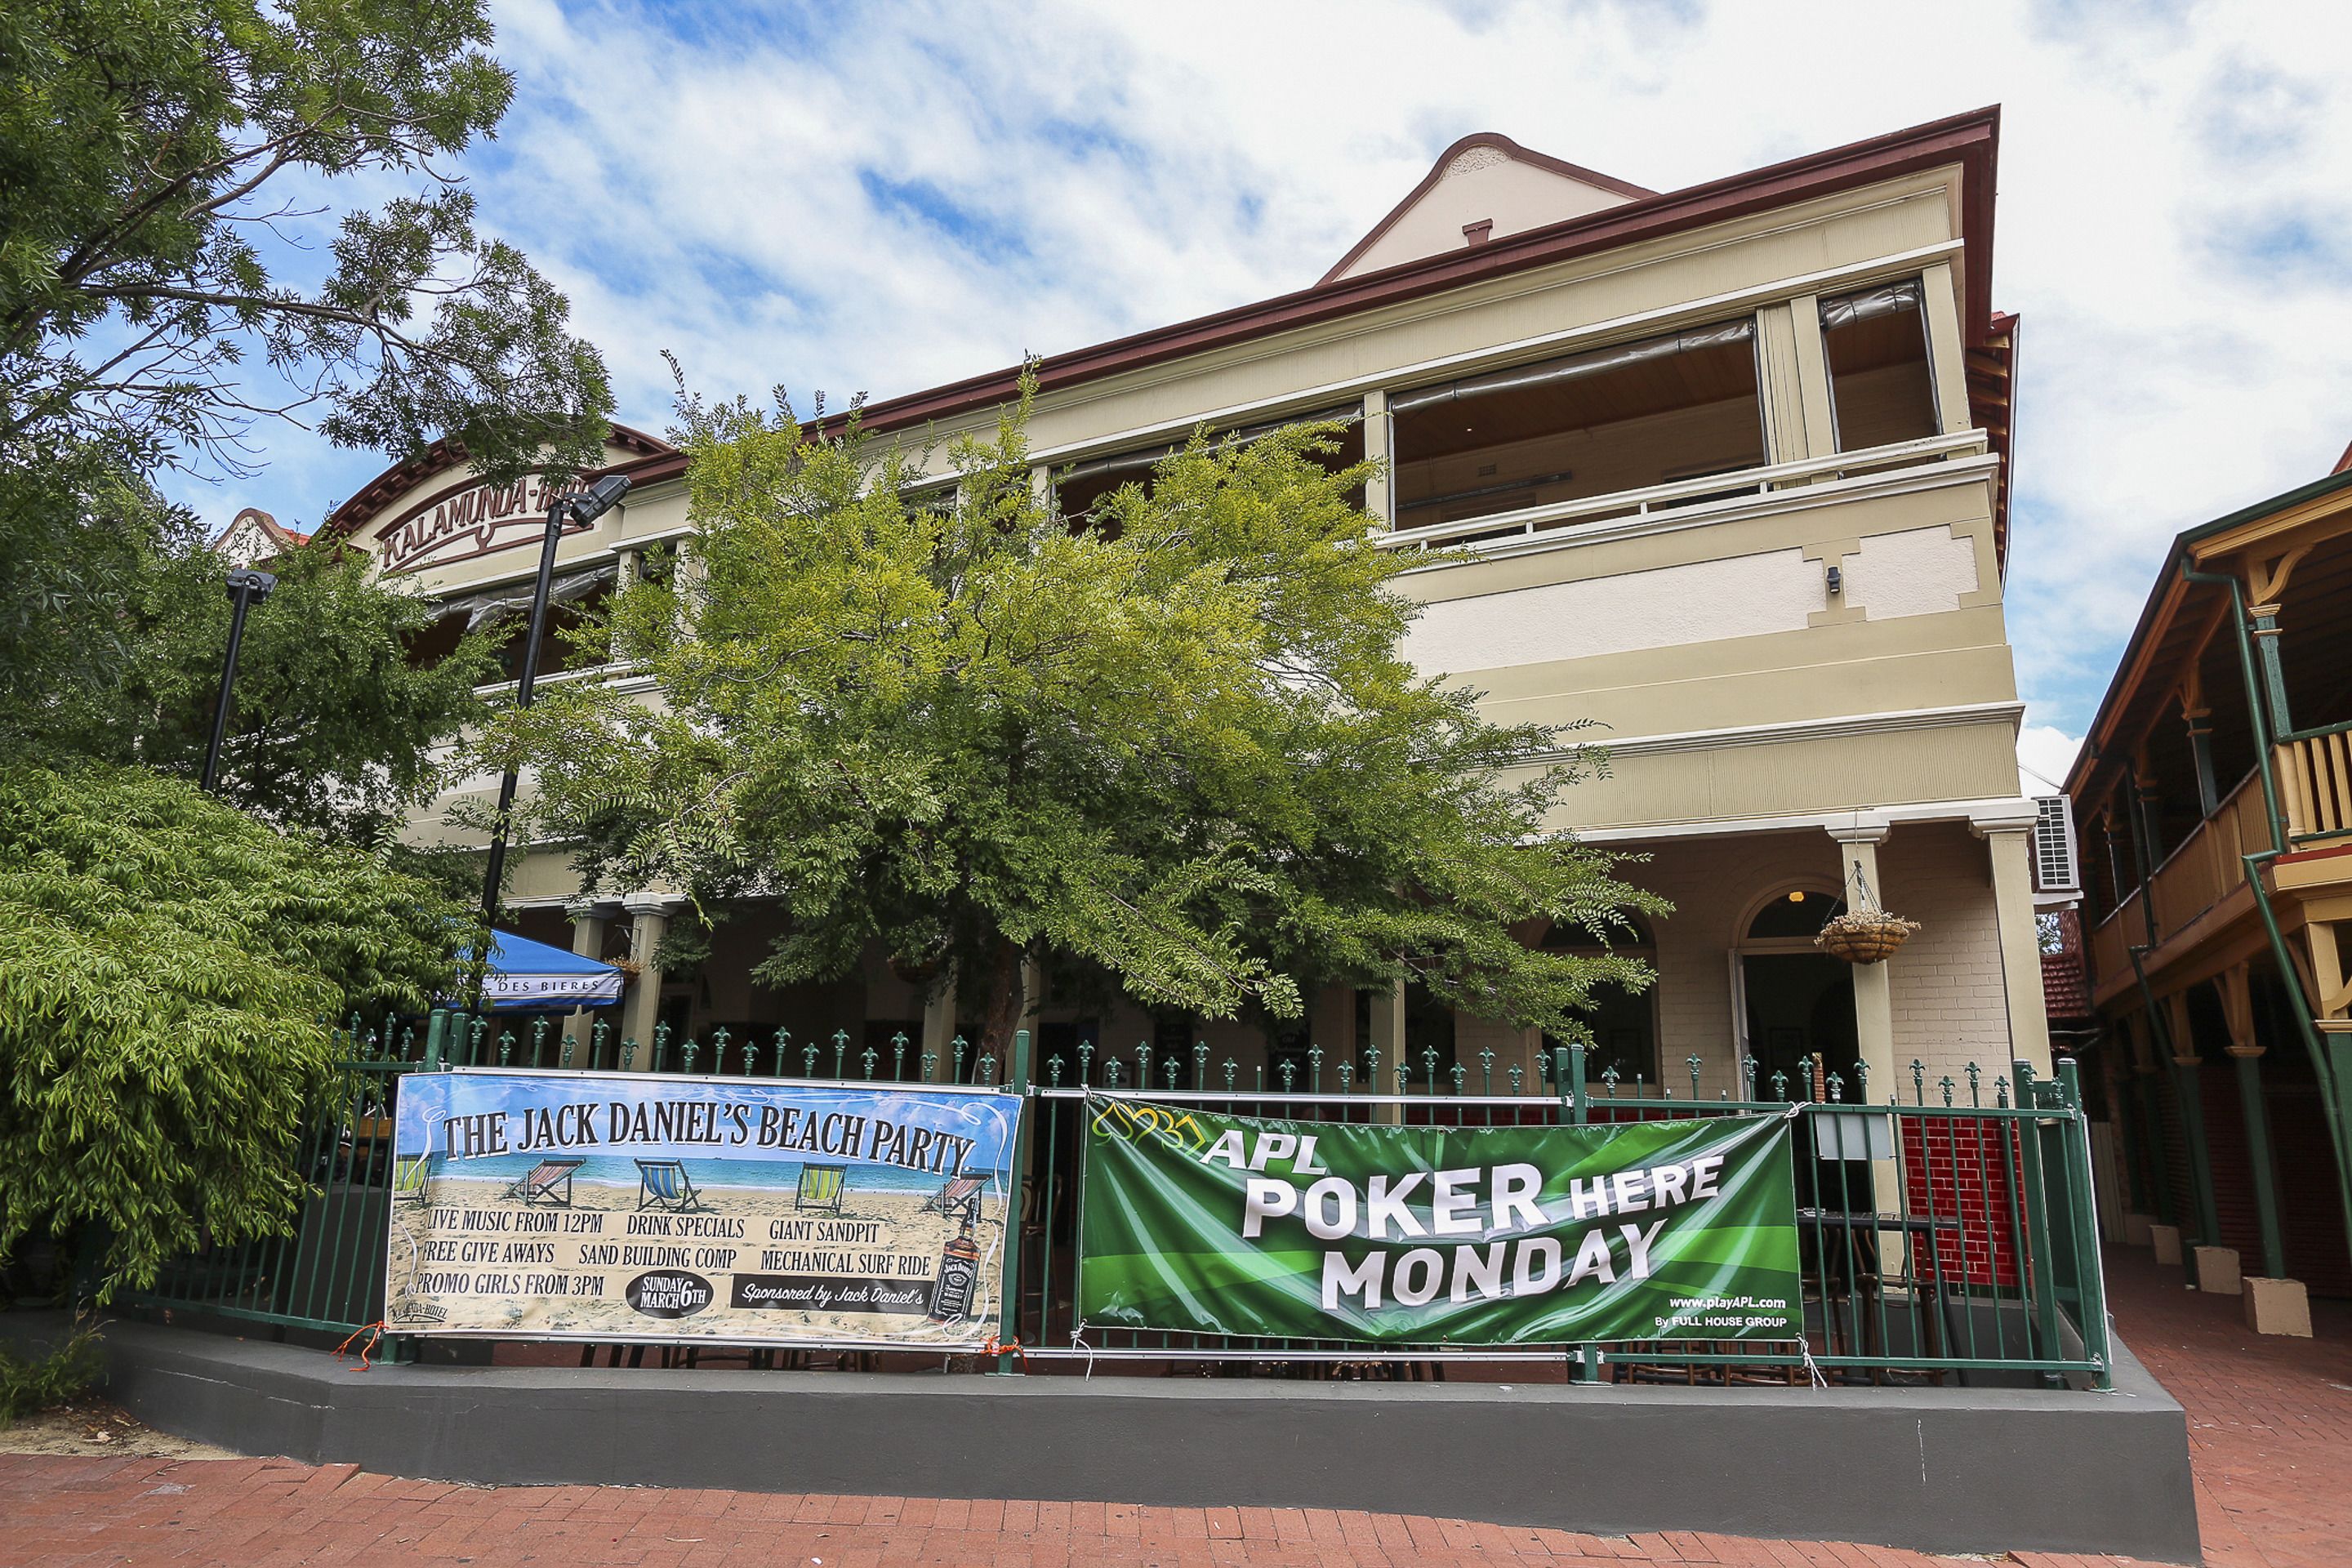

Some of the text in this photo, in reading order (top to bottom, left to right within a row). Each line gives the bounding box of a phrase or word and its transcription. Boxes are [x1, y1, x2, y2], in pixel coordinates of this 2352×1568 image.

[498, 980, 599, 991] DES BIERES
[443, 1101, 977, 1179] THE JACK DANIEL'S BEACH PARTY
[1199, 1129, 1327, 1175] APL
[1242, 1155, 1725, 1240] POKER HERE
[427, 1209, 604, 1233] LIVE MUSIC FROM 12PM
[626, 1214, 745, 1239] DRINK SPECIALS
[769, 1219, 880, 1244] GIANT SANDPIT
[421, 1241, 555, 1263] FREE GIVE AWAYS
[579, 1244, 737, 1269] SAND BUILDING COMP
[760, 1250, 932, 1276] MECHANICAL SURF RIDE
[1322, 1218, 1668, 1311] MONDAY
[415, 1272, 605, 1296] PROMO GIRLS FROM 3PM
[642, 1276, 685, 1293] SUNDAY
[742, 1283, 813, 1303] Sponsored
[814, 1285, 832, 1308] by
[835, 1285, 869, 1303] Jack
[871, 1286, 924, 1305] Daniel's
[640, 1292, 680, 1310] MARCH
[1669, 1296, 1786, 1310] www.playAPL.com
[1655, 1316, 1787, 1328] By FULL HOUSE GROUP
